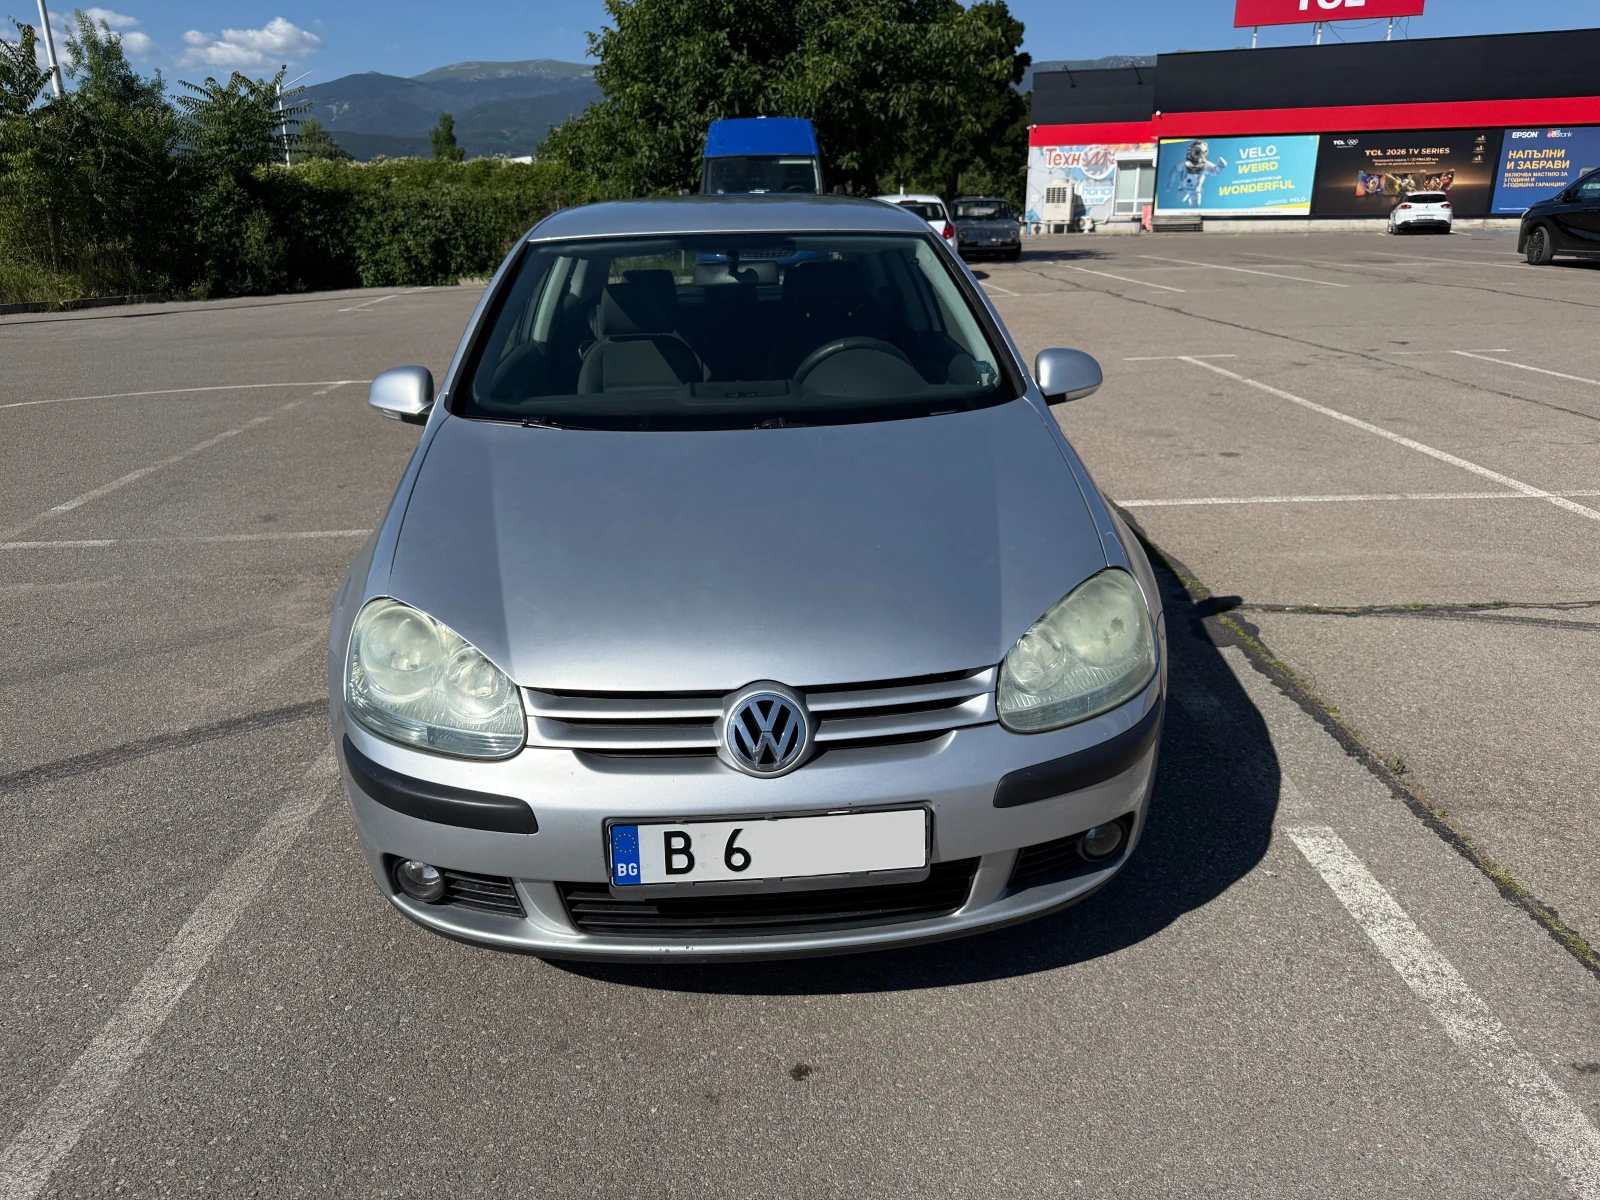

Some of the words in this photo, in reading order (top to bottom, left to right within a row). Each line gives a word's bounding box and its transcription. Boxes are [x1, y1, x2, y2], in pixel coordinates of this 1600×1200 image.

[1512, 131, 1539, 139] EPSON
[1239, 145, 1277, 159] VELO
[1386, 148, 1407, 156] 2026
[1421, 147, 1450, 155] SERIES
[1508, 149, 1566, 159] НАПЪЛНИ
[1238, 161, 1279, 174] WEIRD
[1506, 161, 1515, 170] И
[1517, 160, 1571, 170] ЗАБРАВИ
[1219, 179, 1295, 196] WONDERFUL
[664, 830, 696, 875] B
[724, 828, 752, 872] 6
[617, 863, 638, 877] BG
